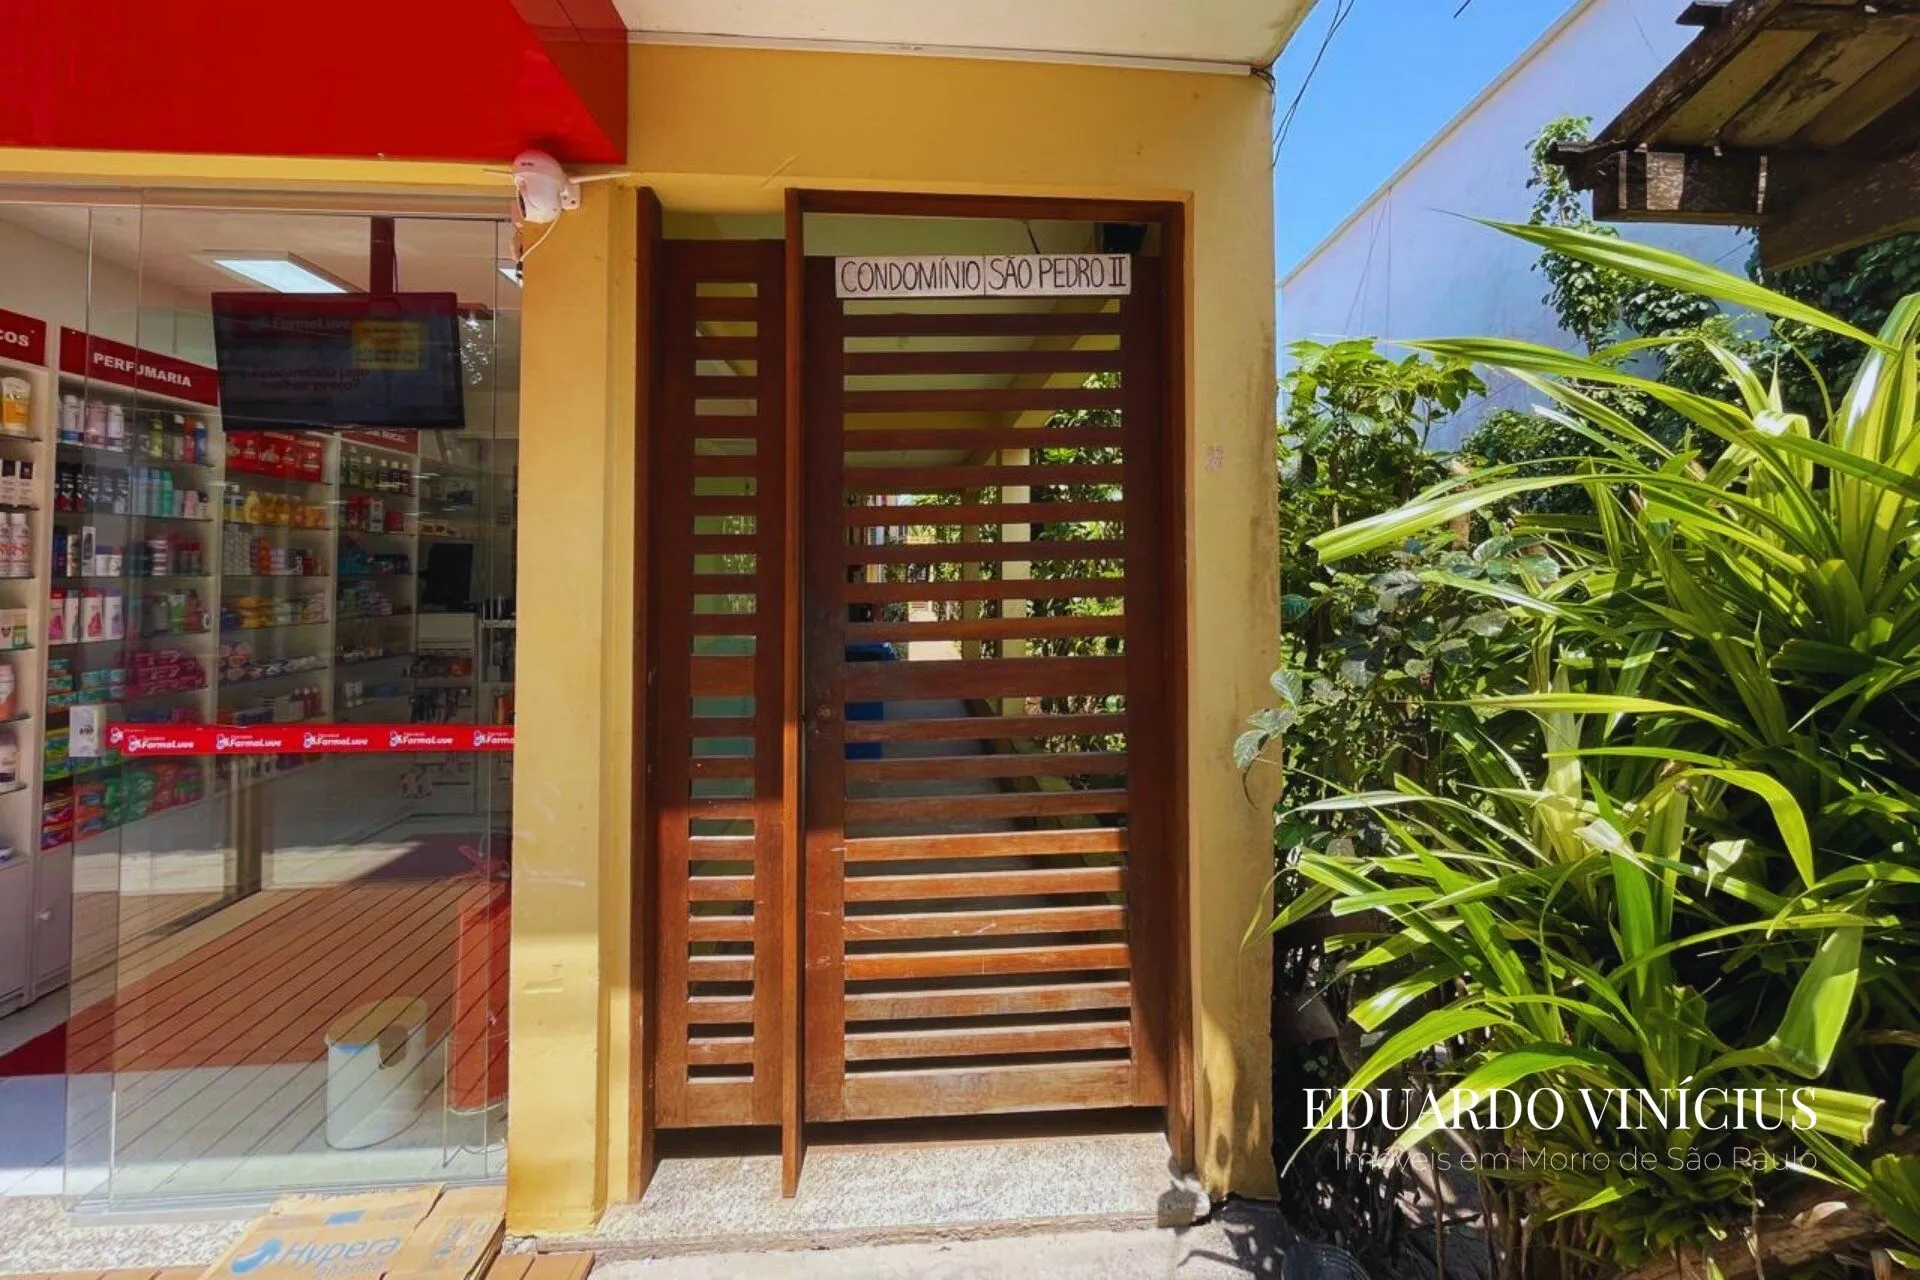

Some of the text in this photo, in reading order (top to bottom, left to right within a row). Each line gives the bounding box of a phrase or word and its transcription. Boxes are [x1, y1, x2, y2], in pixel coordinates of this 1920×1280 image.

[841, 257, 980, 292] CONDOMÍNIO
[988, 256, 1032, 290] SÃO
[1038, 257, 1105, 289] PEDRO
[92, 351, 192, 387] PERFUMARIA
[281, 1236, 402, 1270] Hypera
